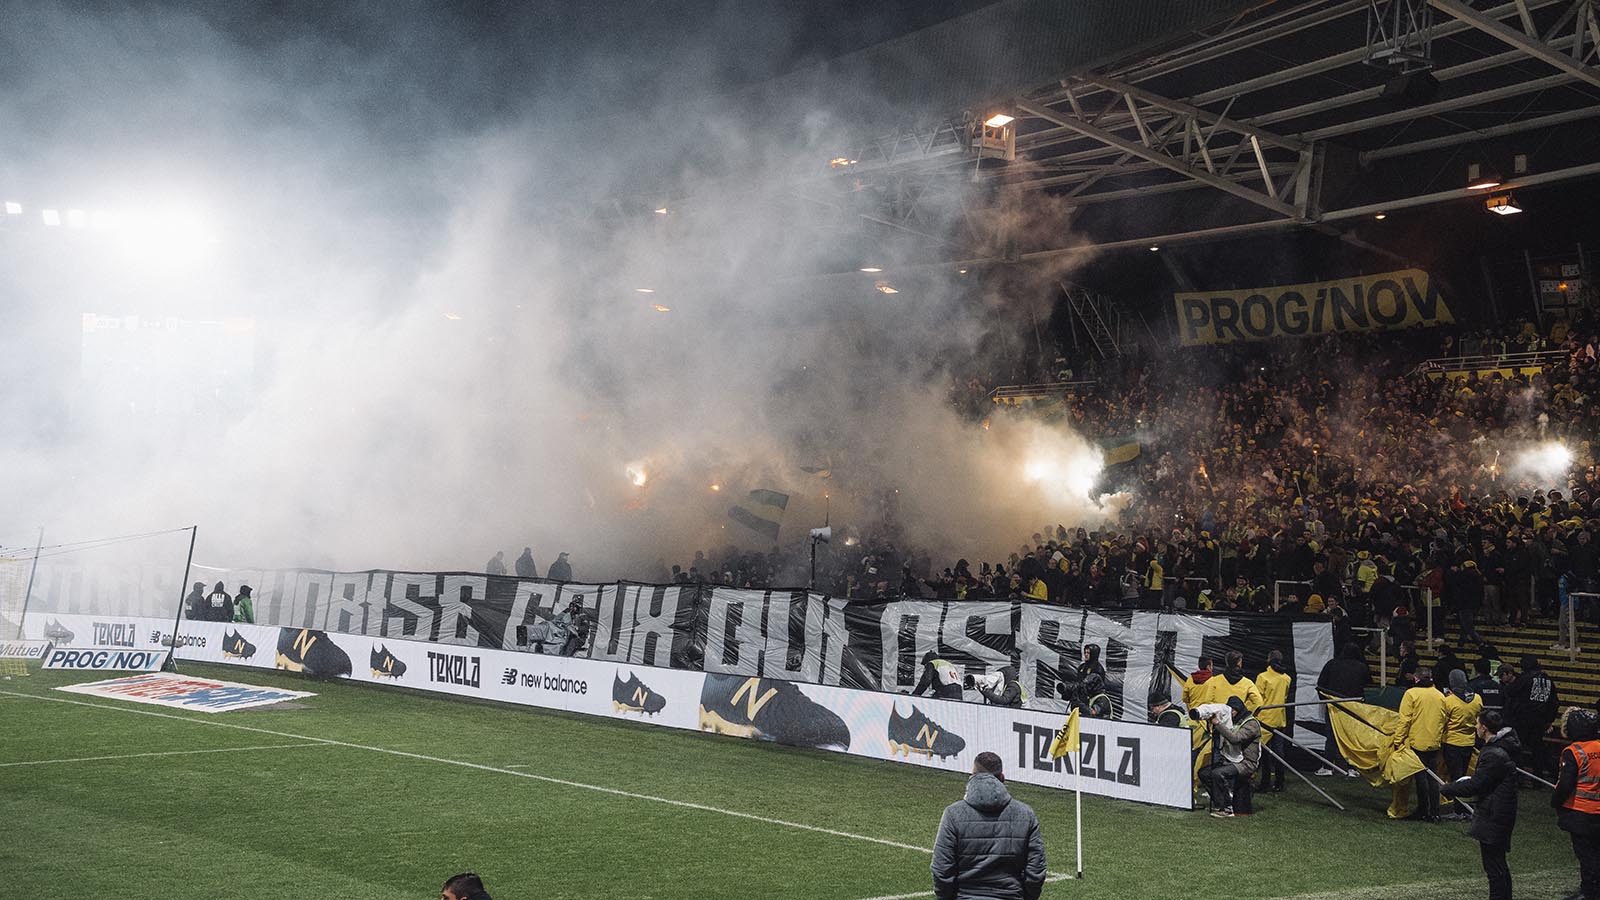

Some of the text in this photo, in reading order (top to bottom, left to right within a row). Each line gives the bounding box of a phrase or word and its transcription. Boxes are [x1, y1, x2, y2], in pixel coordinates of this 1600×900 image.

[521, 673, 542, 688] new
[544, 672, 587, 695] balance
[704, 587, 849, 686] QUI
[880, 600, 1230, 722] OSENT
